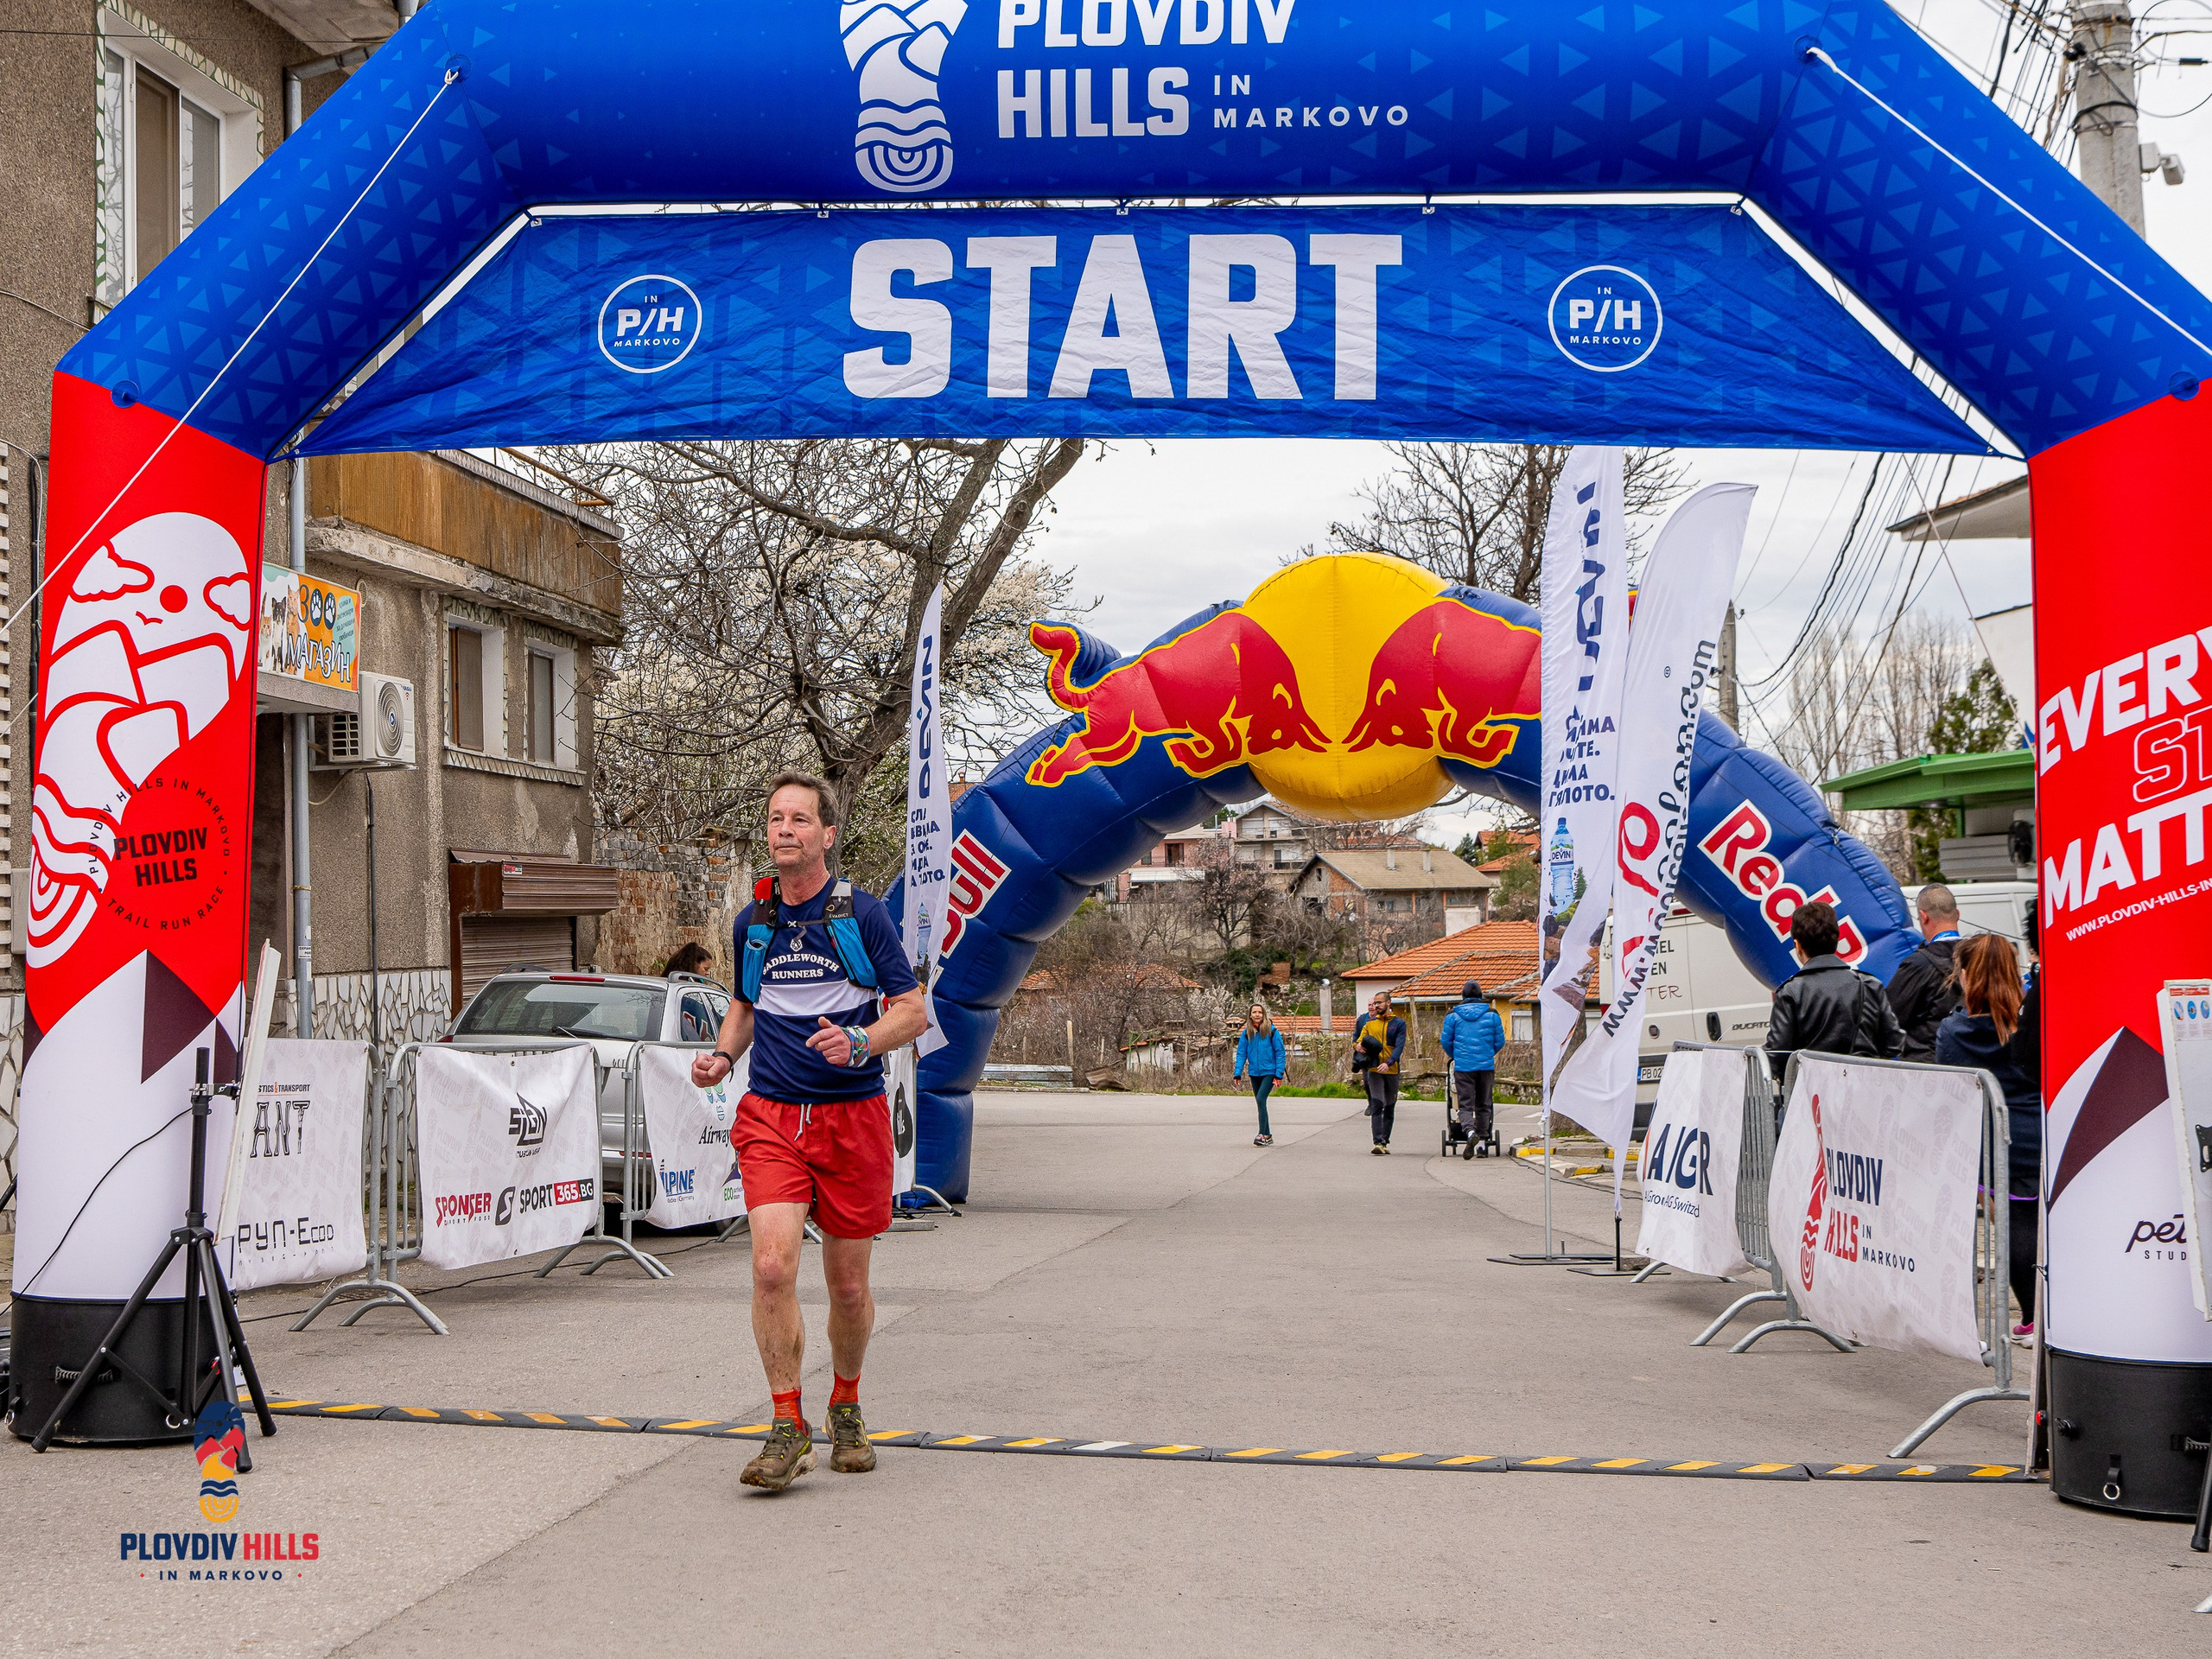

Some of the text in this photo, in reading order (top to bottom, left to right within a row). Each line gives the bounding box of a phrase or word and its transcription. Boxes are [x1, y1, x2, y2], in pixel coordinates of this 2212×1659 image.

[998, 0, 1294, 48] PLOVDIV
[1213, 74, 1250, 96] IN
[998, 67, 1190, 138] HILLS
[1213, 105, 1409, 129] MARKOVO
[617, 307, 684, 336] P/H
[842, 234, 1402, 400] START
[1569, 299, 1641, 333] P/H
[613, 338, 680, 346] MARKOVO
[1570, 335, 1641, 345] MARKOVO
[287, 632, 351, 683] МАГАЗИН
[919, 635, 932, 799] DEVIN
[88, 778, 230, 874] PLOVDIV HILLS IN MARKOVO
[113, 827, 207, 861] PLOVDIV
[1552, 849, 1571, 861] DEVIN
[135, 858, 197, 887] HILLS
[107, 886, 223, 930] TRAIL RUN RACE
[772, 969, 823, 979] RUNNERS
[278, 1084, 310, 1093] TRANSPORT
[1827, 1147, 1884, 1206] PLOVDIV
[1862, 1224, 1872, 1239] IN
[1862, 1246, 1916, 1273] MARKOVO
[2144, 1249, 2187, 1261] STUD
